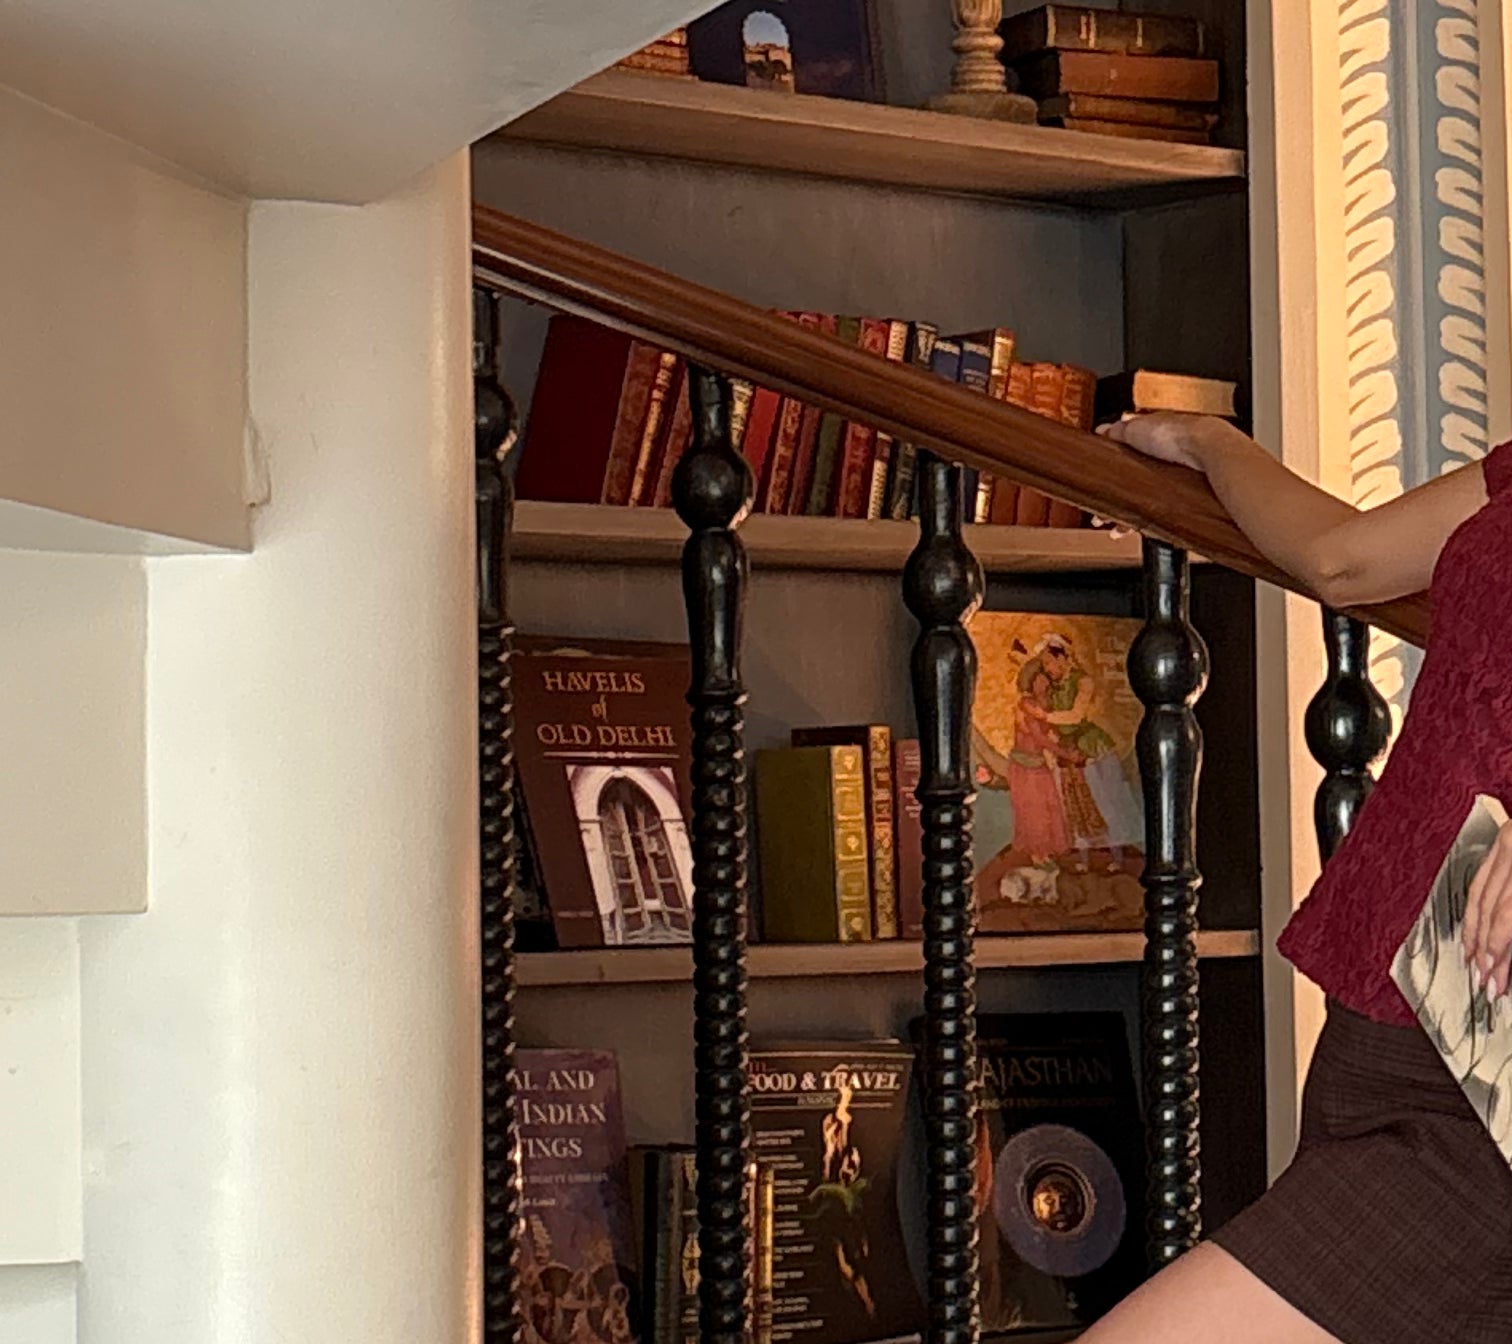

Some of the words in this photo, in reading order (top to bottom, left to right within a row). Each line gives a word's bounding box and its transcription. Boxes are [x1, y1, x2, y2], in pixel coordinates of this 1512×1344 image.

[542, 671, 645, 693] HAVELIS
[591, 694, 608, 722] of
[536, 723, 592, 746] OLD
[597, 725, 677, 747] DELHI
[546, 1070, 595, 1091] AND
[800, 1072, 817, 1091] &
[821, 1071, 901, 1090] TRAVEL
[522, 1099, 607, 1125] INDIAN
